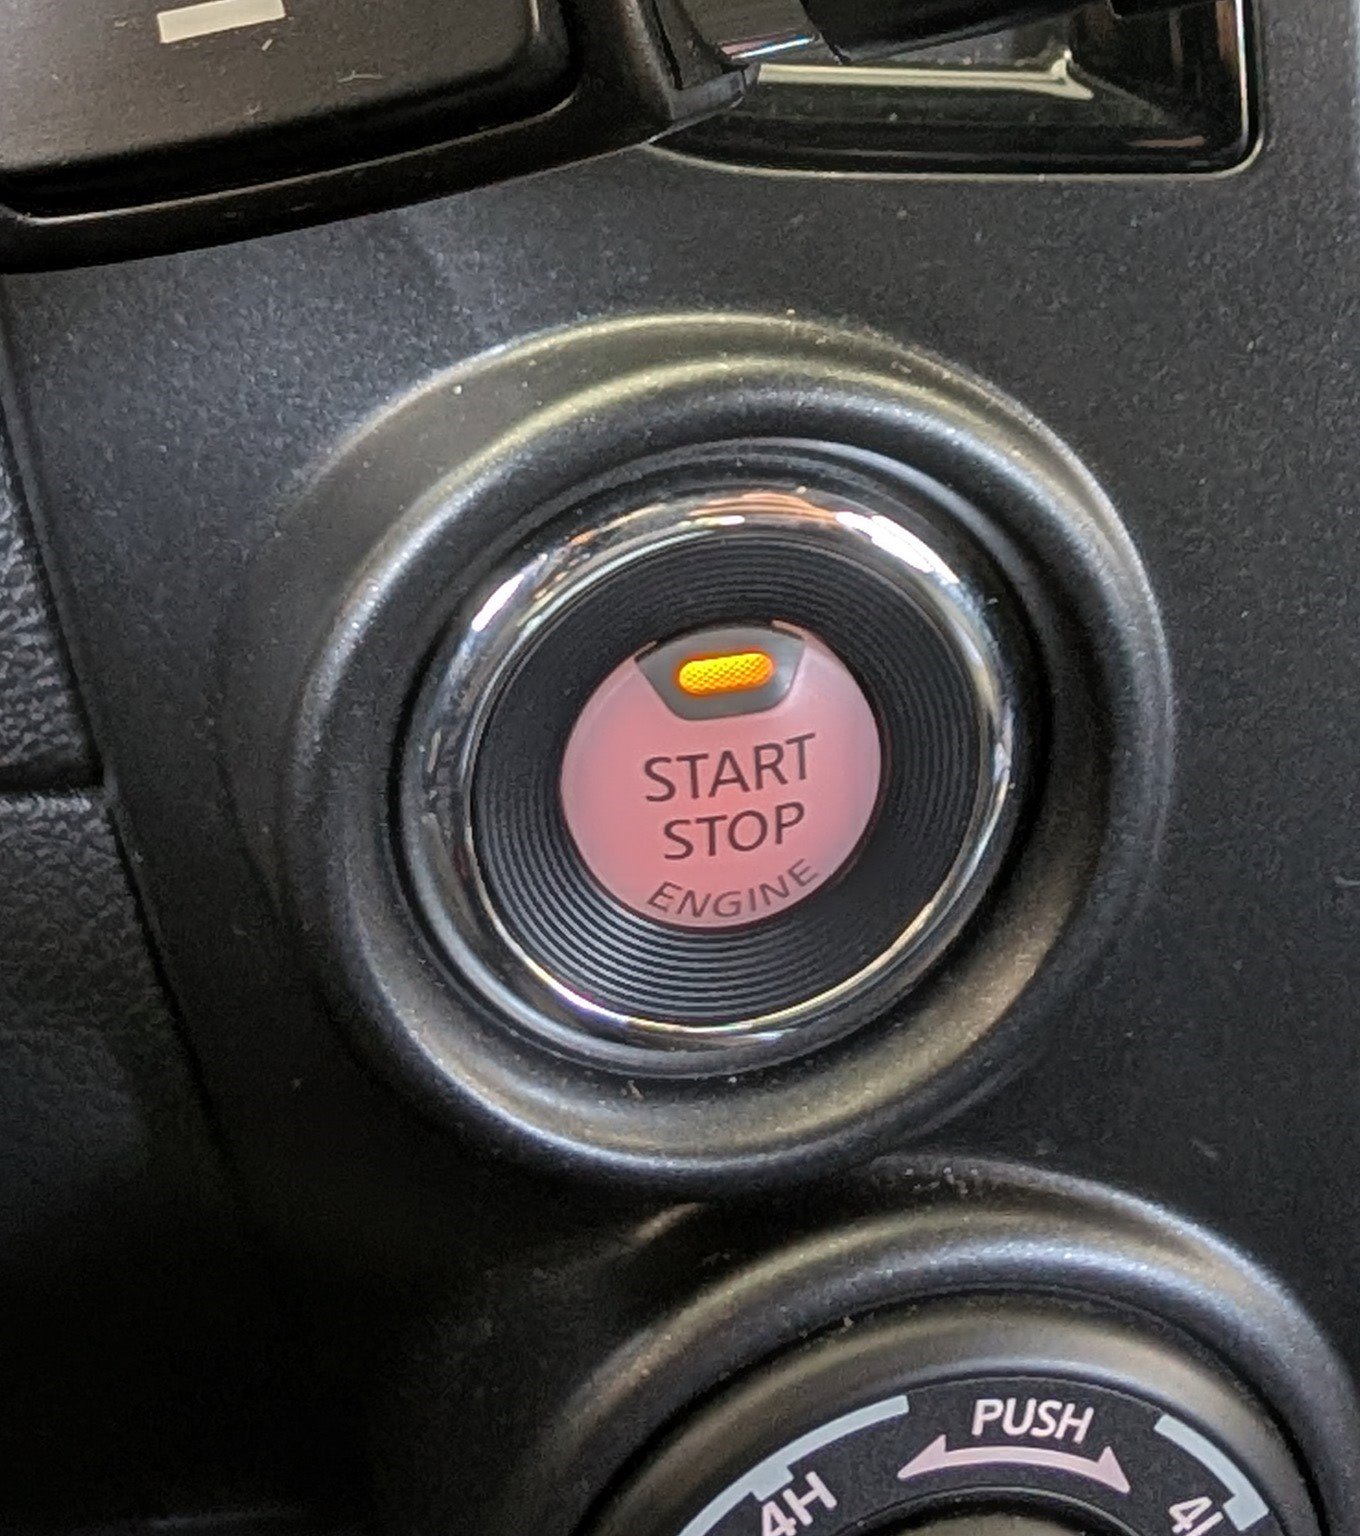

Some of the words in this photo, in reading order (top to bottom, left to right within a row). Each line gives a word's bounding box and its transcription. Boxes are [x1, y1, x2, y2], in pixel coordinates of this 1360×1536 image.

[644, 732, 816, 802] START
[662, 801, 805, 860] STOP
[646, 858, 821, 918] ENGINE
[971, 1398, 1095, 1443] PUSH
[759, 1470, 837, 1536] 4H
